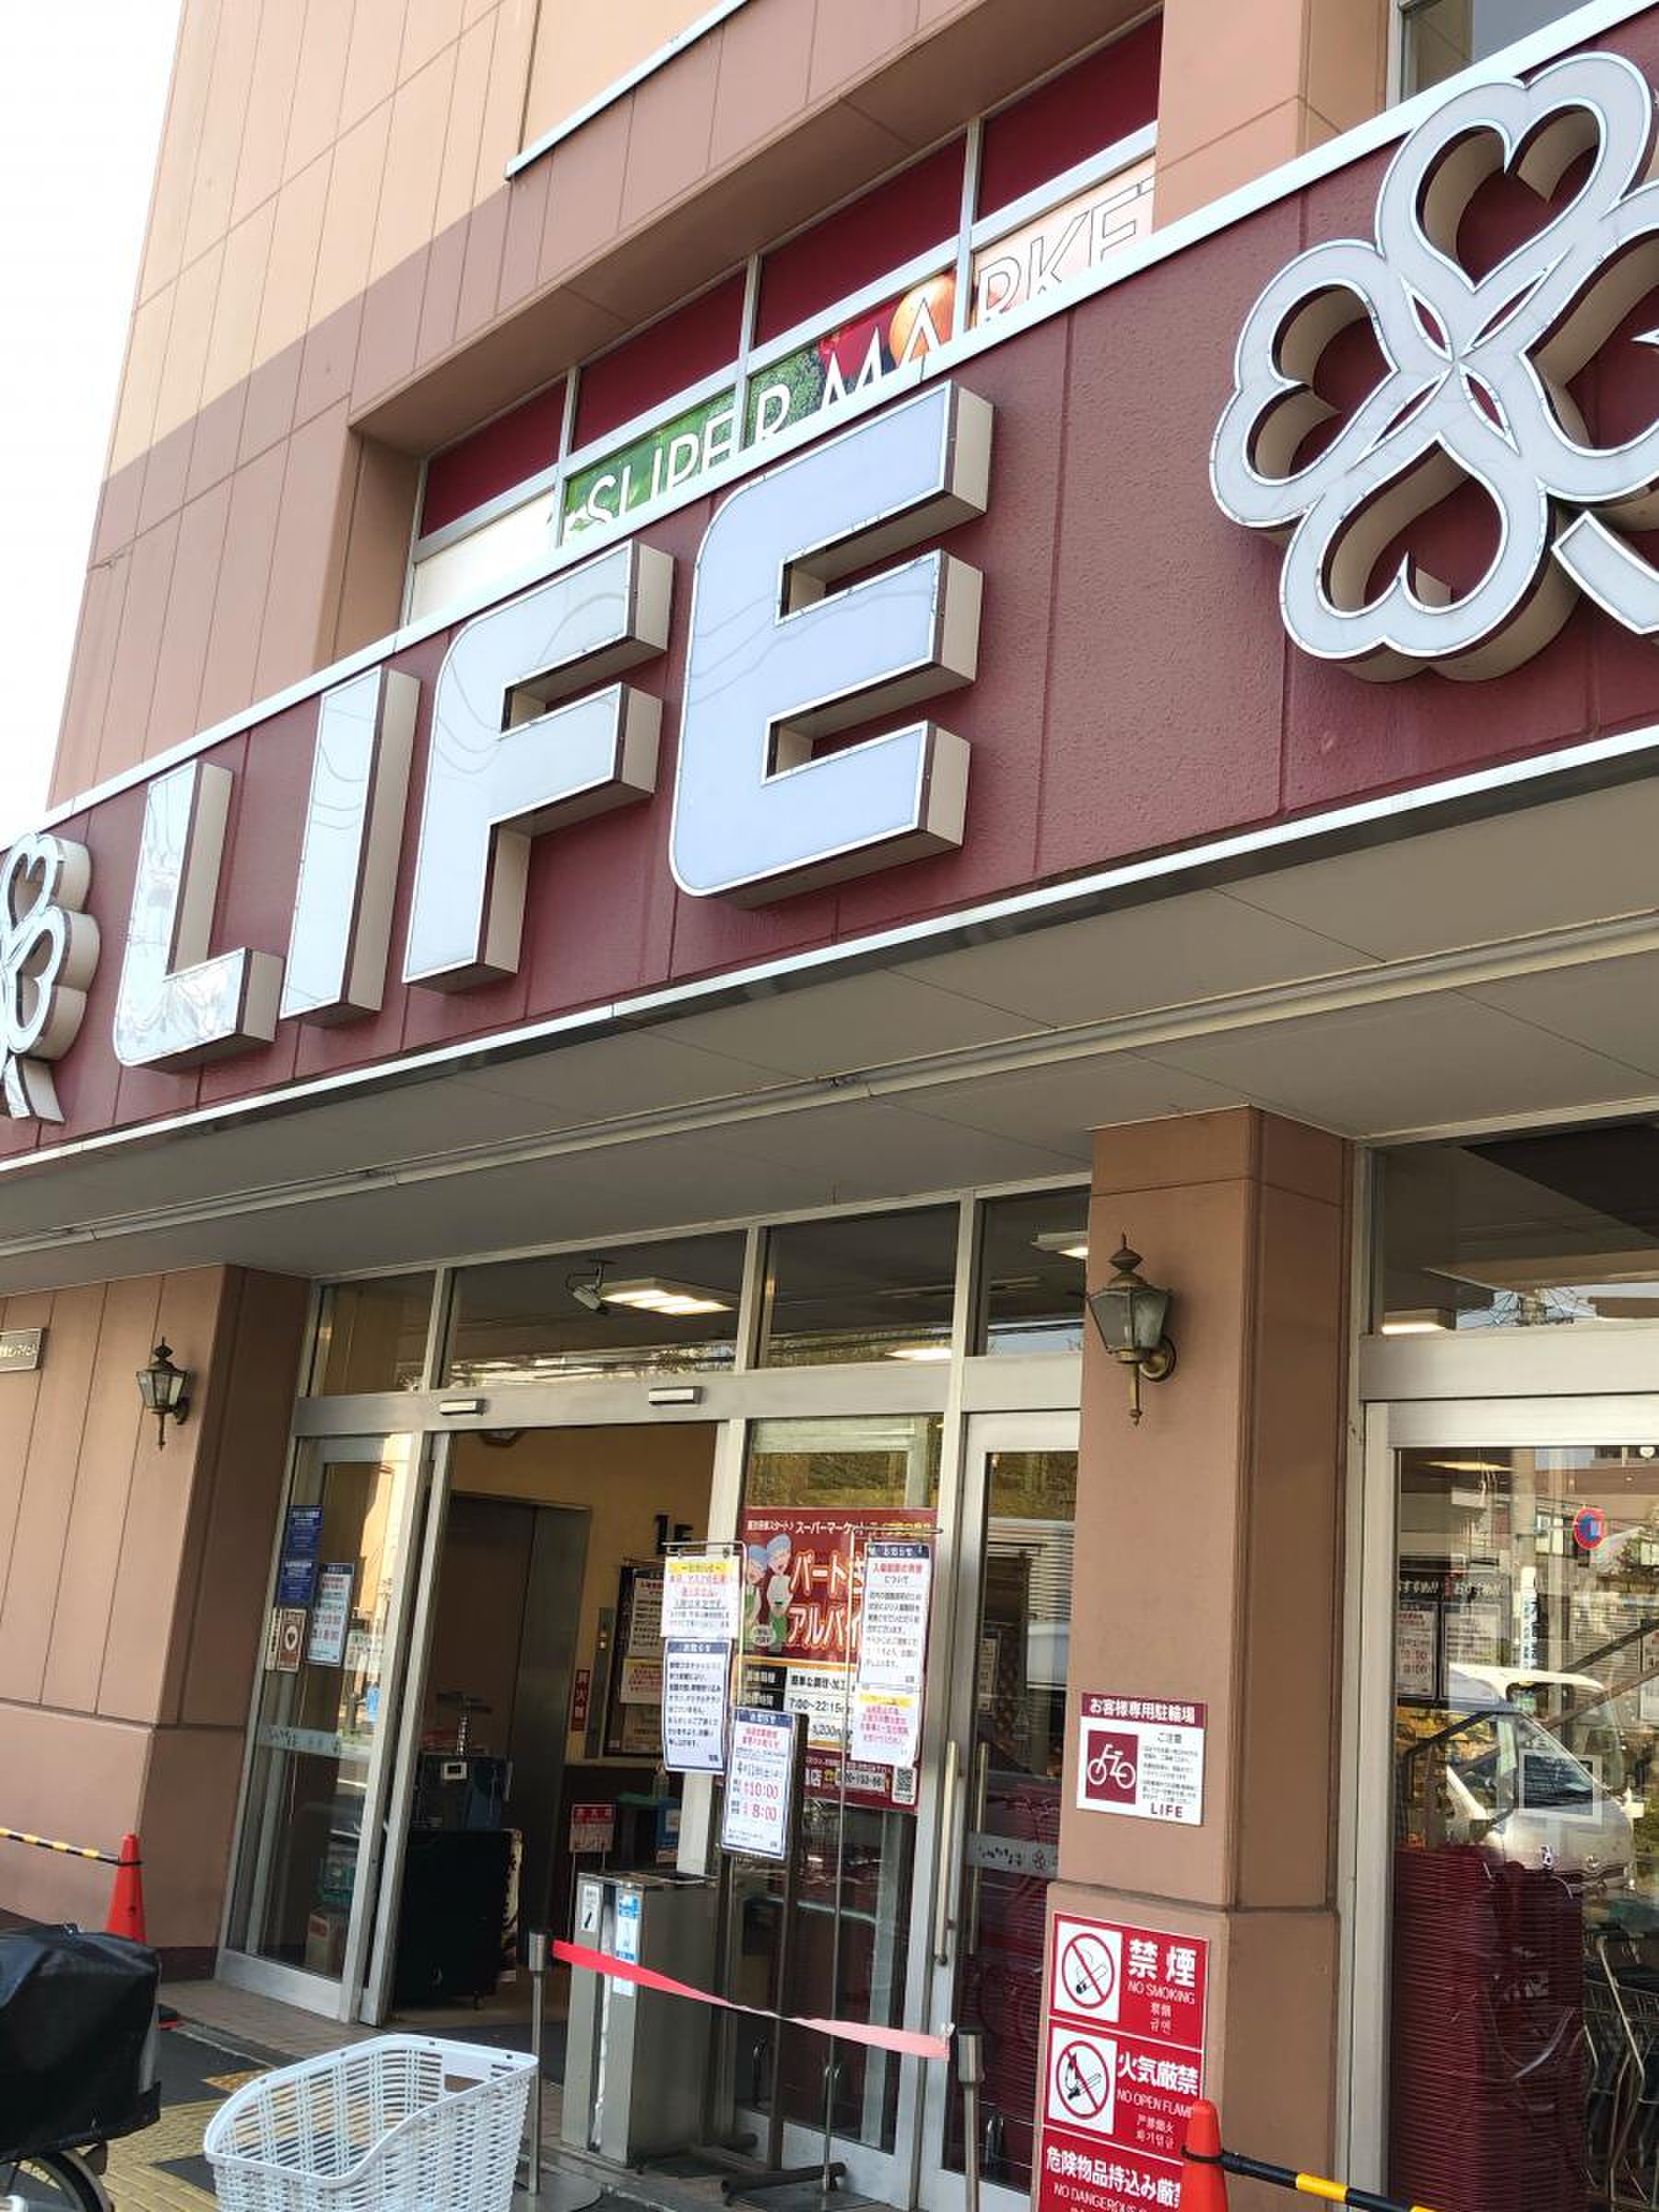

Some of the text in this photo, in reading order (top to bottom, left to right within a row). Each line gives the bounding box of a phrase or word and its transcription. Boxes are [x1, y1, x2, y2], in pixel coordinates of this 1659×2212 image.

[113, 380, 972, 1069] LIFE
[1090, 1699, 1195, 1724] お客様専用駐輪場
[1150, 1802, 1183, 1818] LIFE
[1127, 1980, 1195, 2005] NO SMOKING
[1117, 2052, 1198, 2097] 火気厳禁
[1117, 2088, 1133, 2103] NO
[1134, 2092, 1161, 2110] OPEN
[1053, 2182, 1070, 2198] NO
